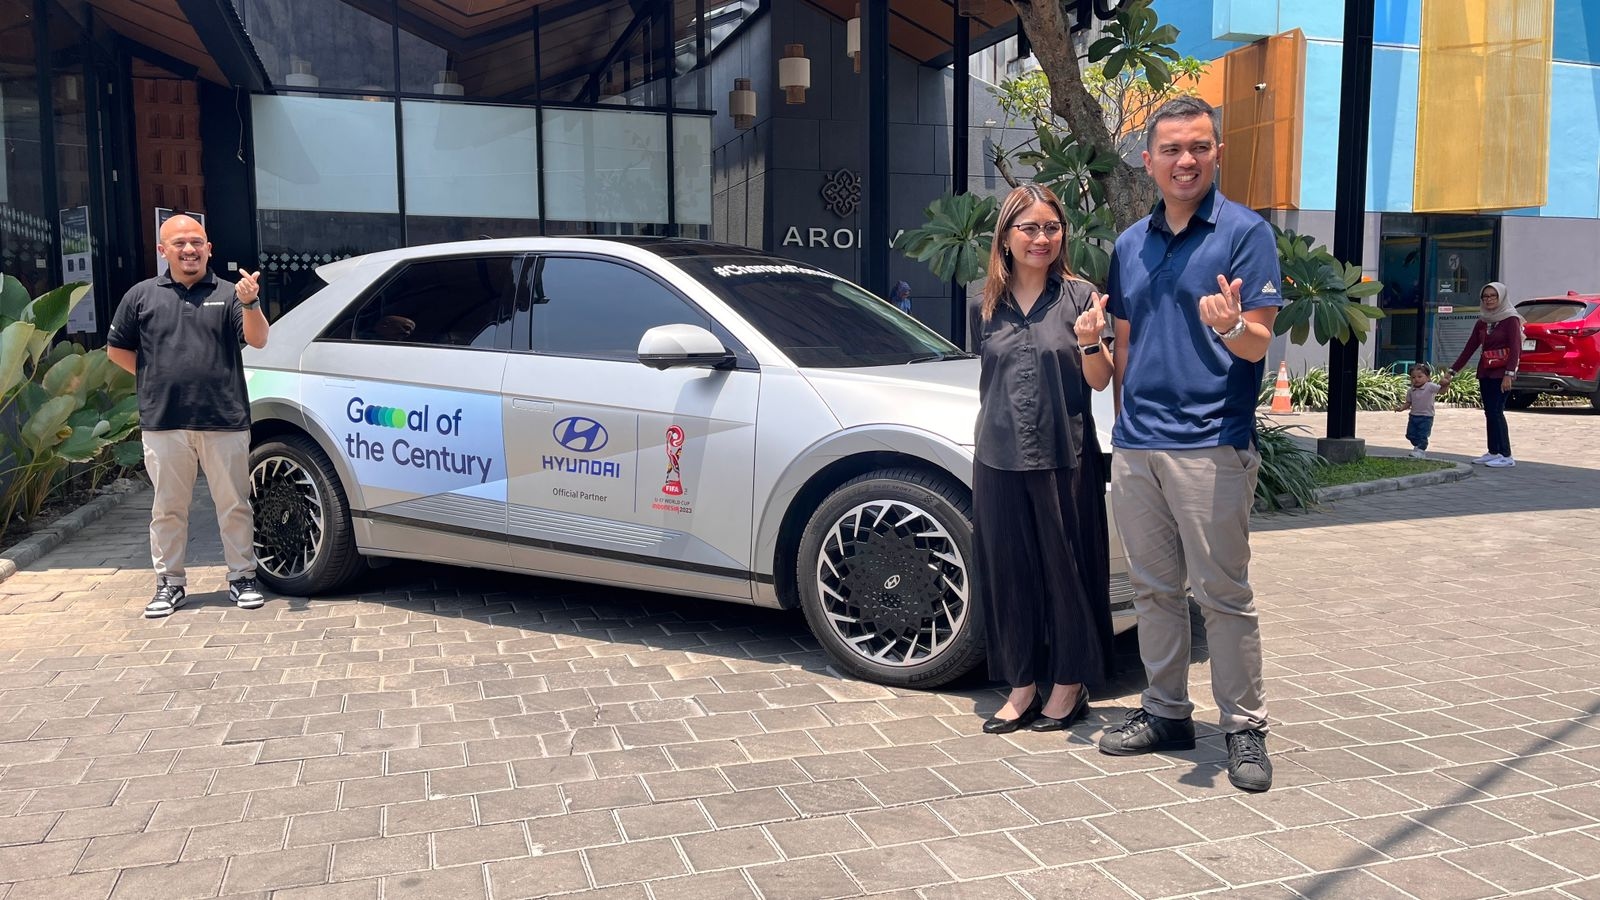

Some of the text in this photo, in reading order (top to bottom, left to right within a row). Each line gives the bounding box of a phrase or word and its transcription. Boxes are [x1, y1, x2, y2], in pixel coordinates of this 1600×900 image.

[436, 408, 463, 437] of
[345, 432, 493, 484] the Century
[542, 455, 620, 478] HYUNDAI
[552, 487, 608, 502] Official Partner
[665, 485, 680, 493] FIFA
[679, 506, 692, 514] 2023
